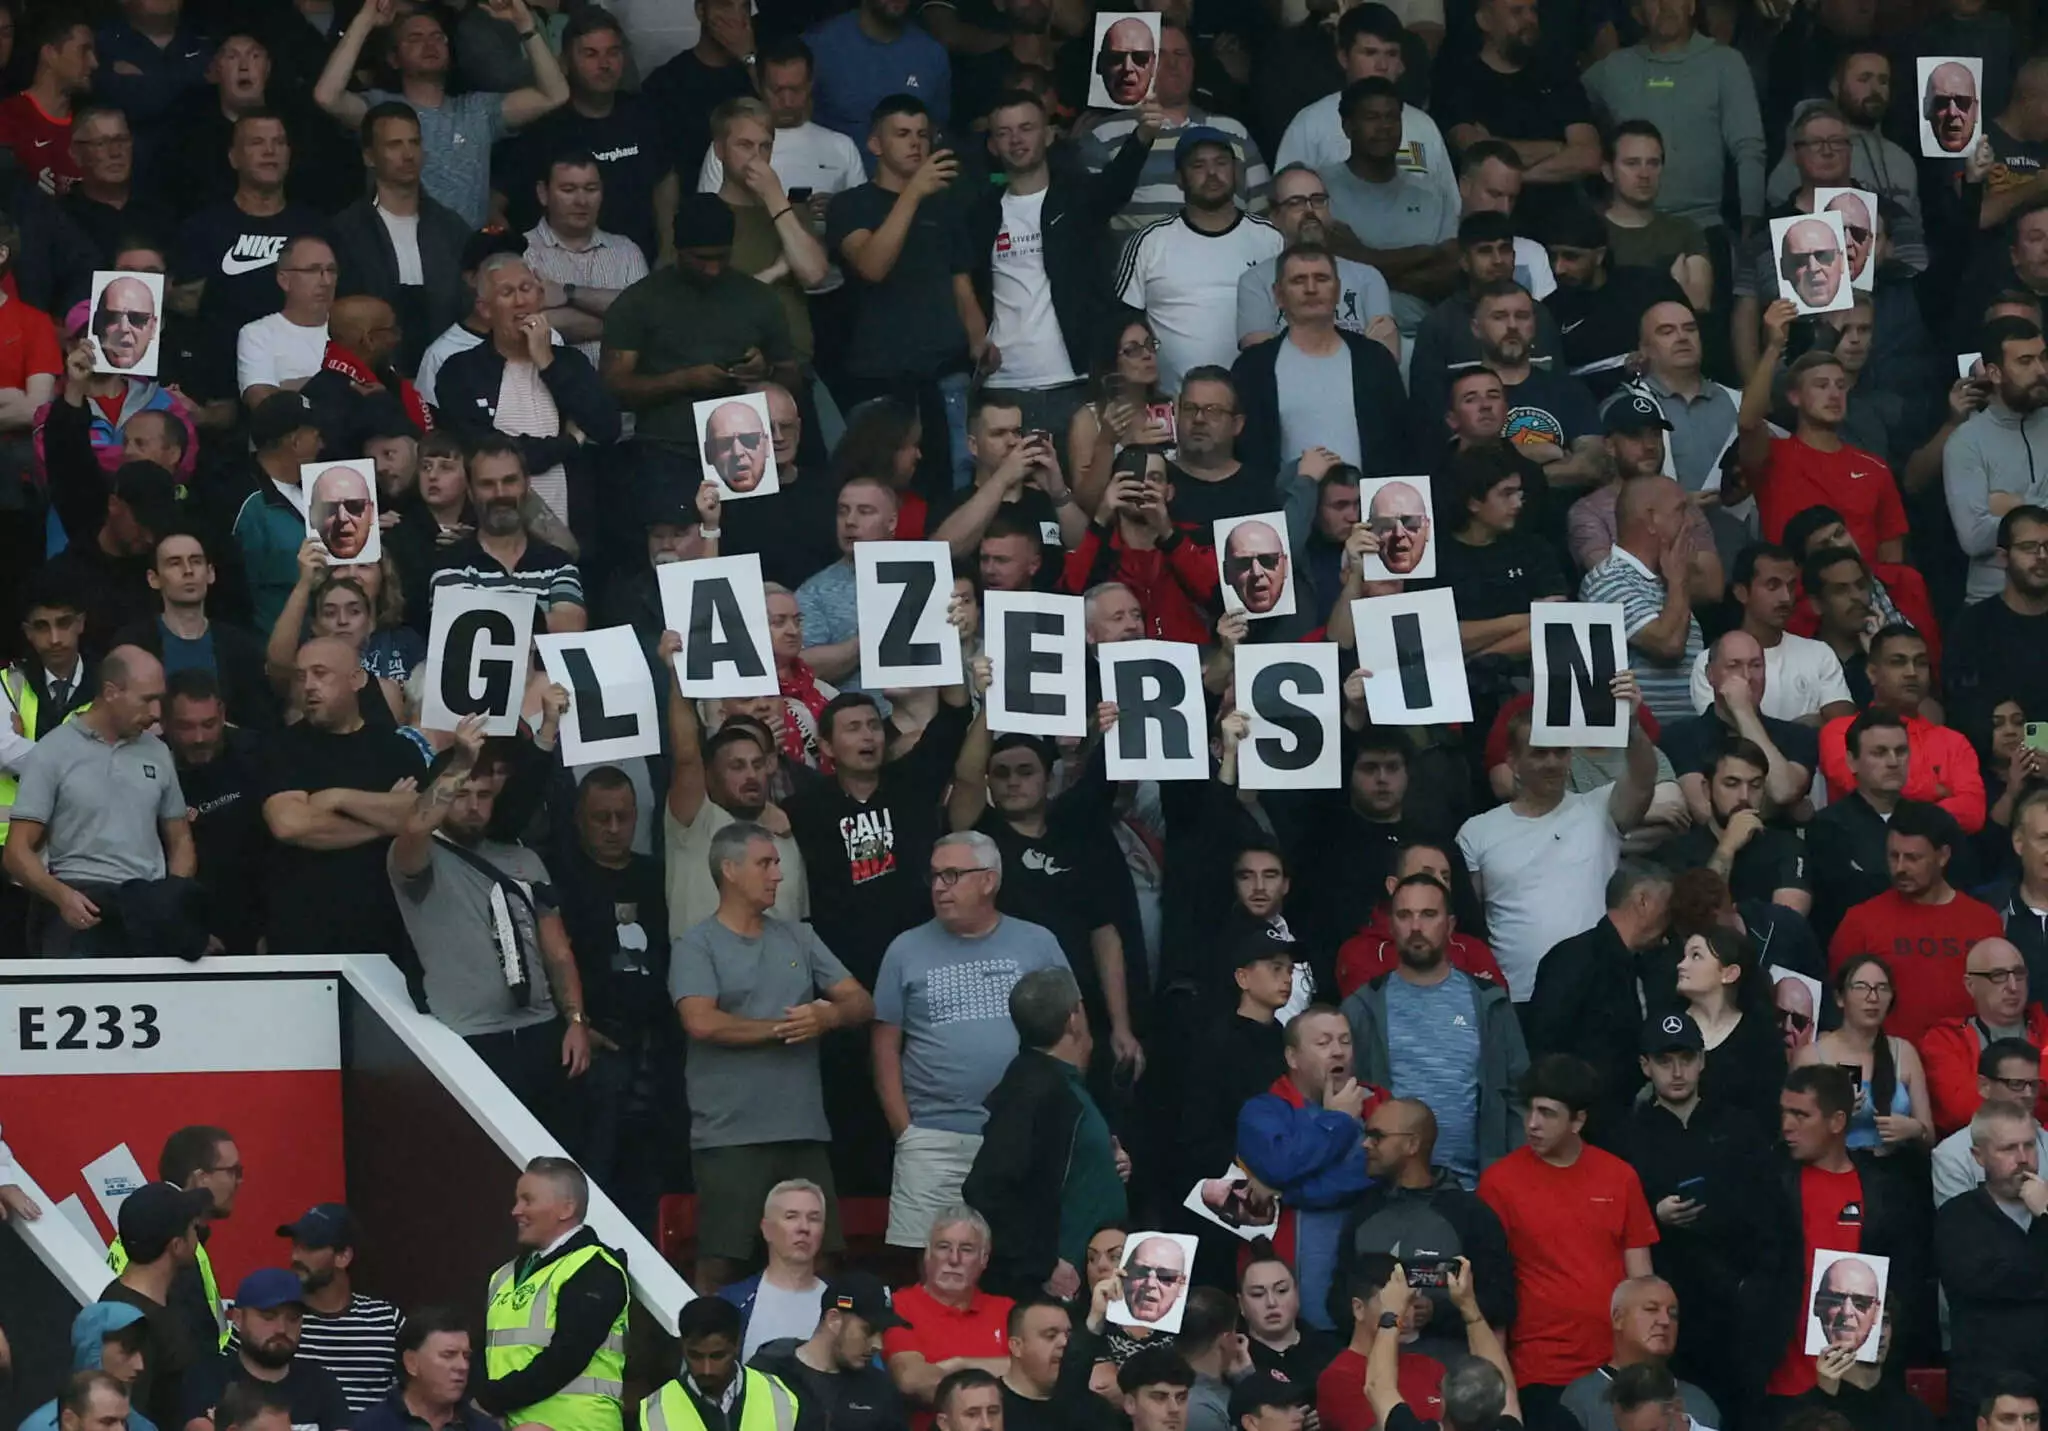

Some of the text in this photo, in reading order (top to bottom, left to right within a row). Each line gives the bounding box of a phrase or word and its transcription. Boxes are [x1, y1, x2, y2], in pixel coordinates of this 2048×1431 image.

[234, 233, 289, 261] NIKE
[441, 609, 515, 717] G
[687, 578, 767, 680] A
[876, 560, 942, 667] Z
[1004, 611, 1067, 715] E
[1391, 612, 1433, 710] I
[561, 647, 640, 743] L
[1114, 659, 1194, 760] R
[1251, 662, 1325, 771] S
[1545, 623, 1616, 727] N
[840, 807, 894, 843] CALI
[19, 1004, 161, 1050] E233
